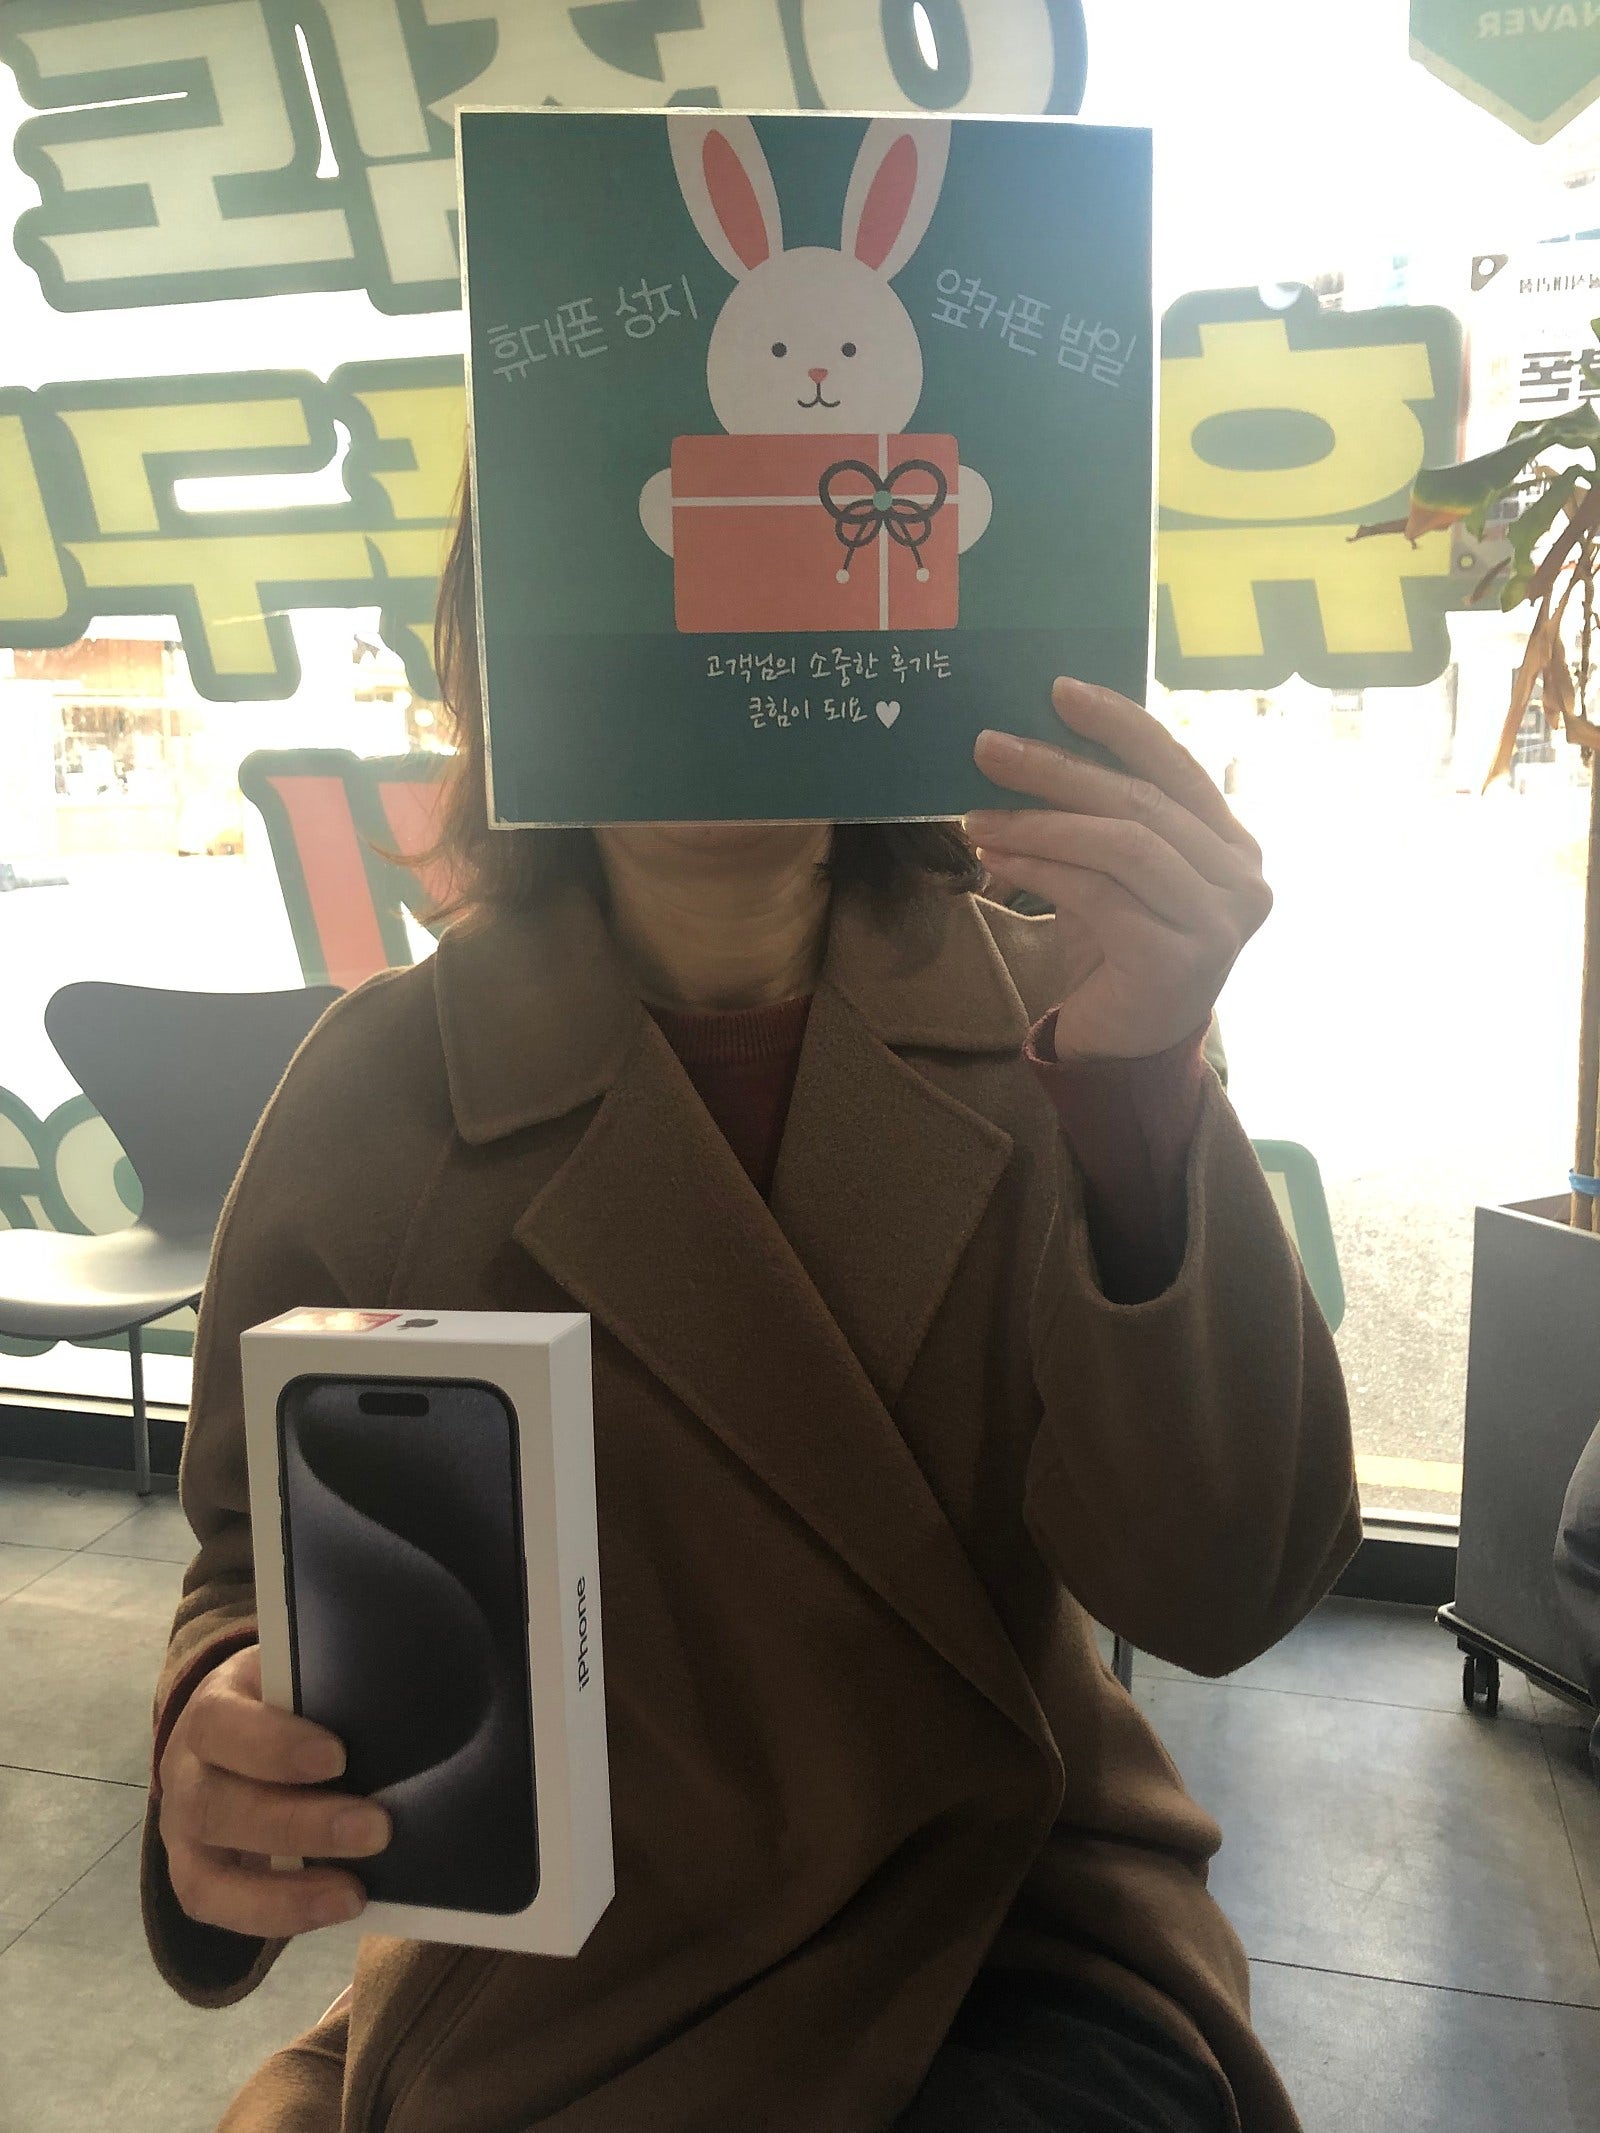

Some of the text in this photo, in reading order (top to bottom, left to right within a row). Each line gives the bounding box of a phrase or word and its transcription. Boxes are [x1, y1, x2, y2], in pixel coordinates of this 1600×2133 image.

[487, 274, 698, 382] 휴대폰 성지
[931, 269, 1137, 387] 옆커폰 범일
[706, 645, 952, 688] 고객님의 소중한 후기는
[749, 696, 811, 729] 큰힘이
[576, 1575, 590, 1693] iPhone
